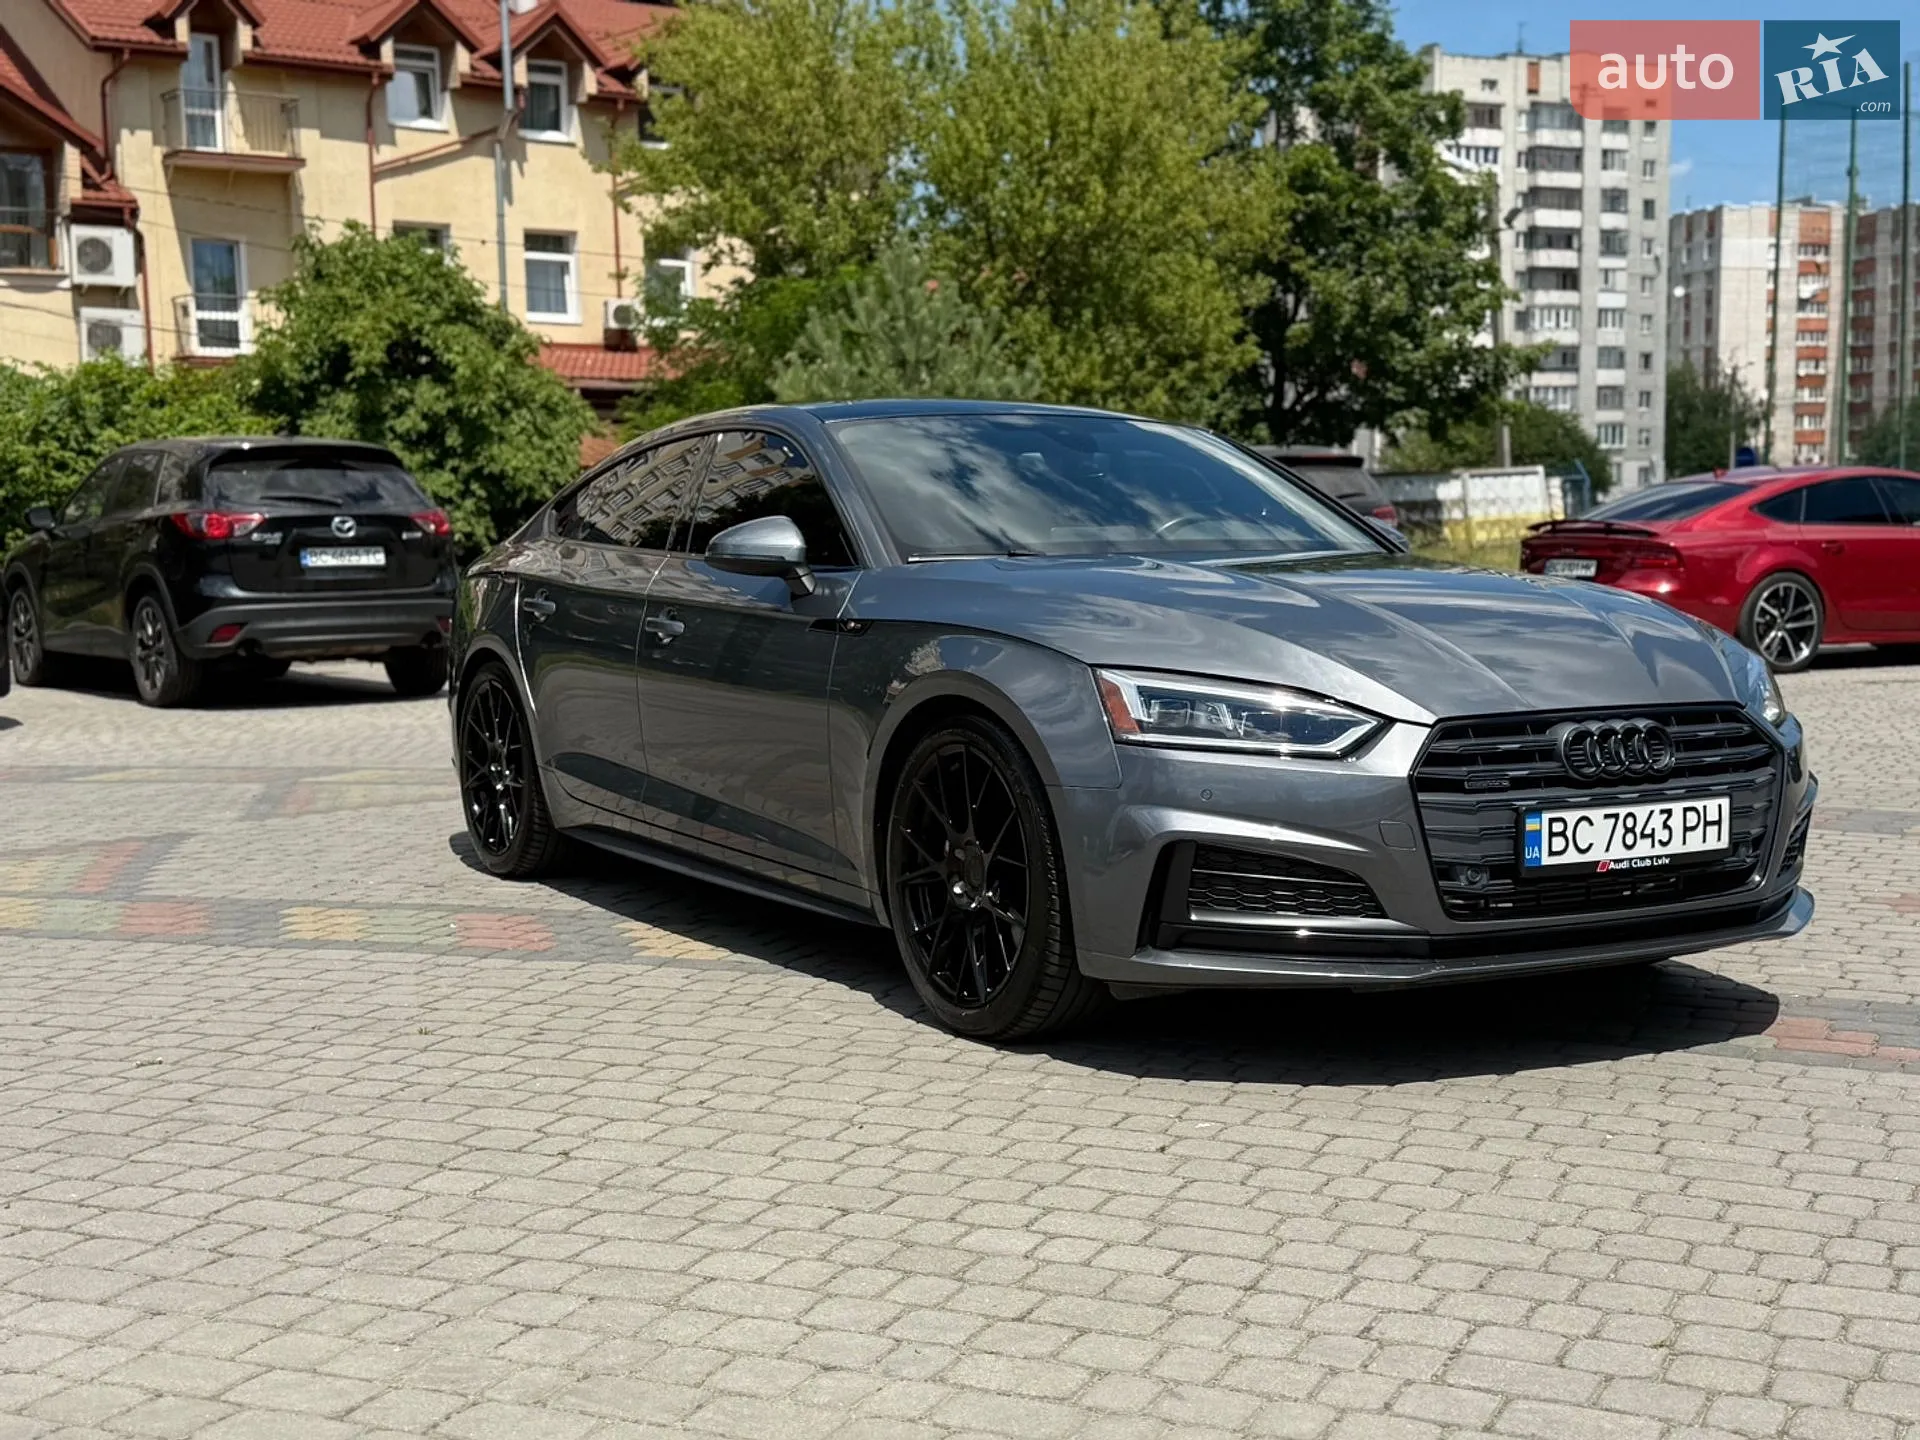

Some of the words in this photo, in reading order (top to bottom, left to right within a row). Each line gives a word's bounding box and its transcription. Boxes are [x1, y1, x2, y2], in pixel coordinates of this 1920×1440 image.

[1548, 815, 1594, 857] BC
[1603, 808, 1673, 853] 7843
[1682, 803, 1722, 846] PH
[1525, 846, 1540, 860] UA
[1608, 860, 1630, 870] Audi
[1631, 858, 1651, 868] Club
[1653, 856, 1671, 866] Lviv
